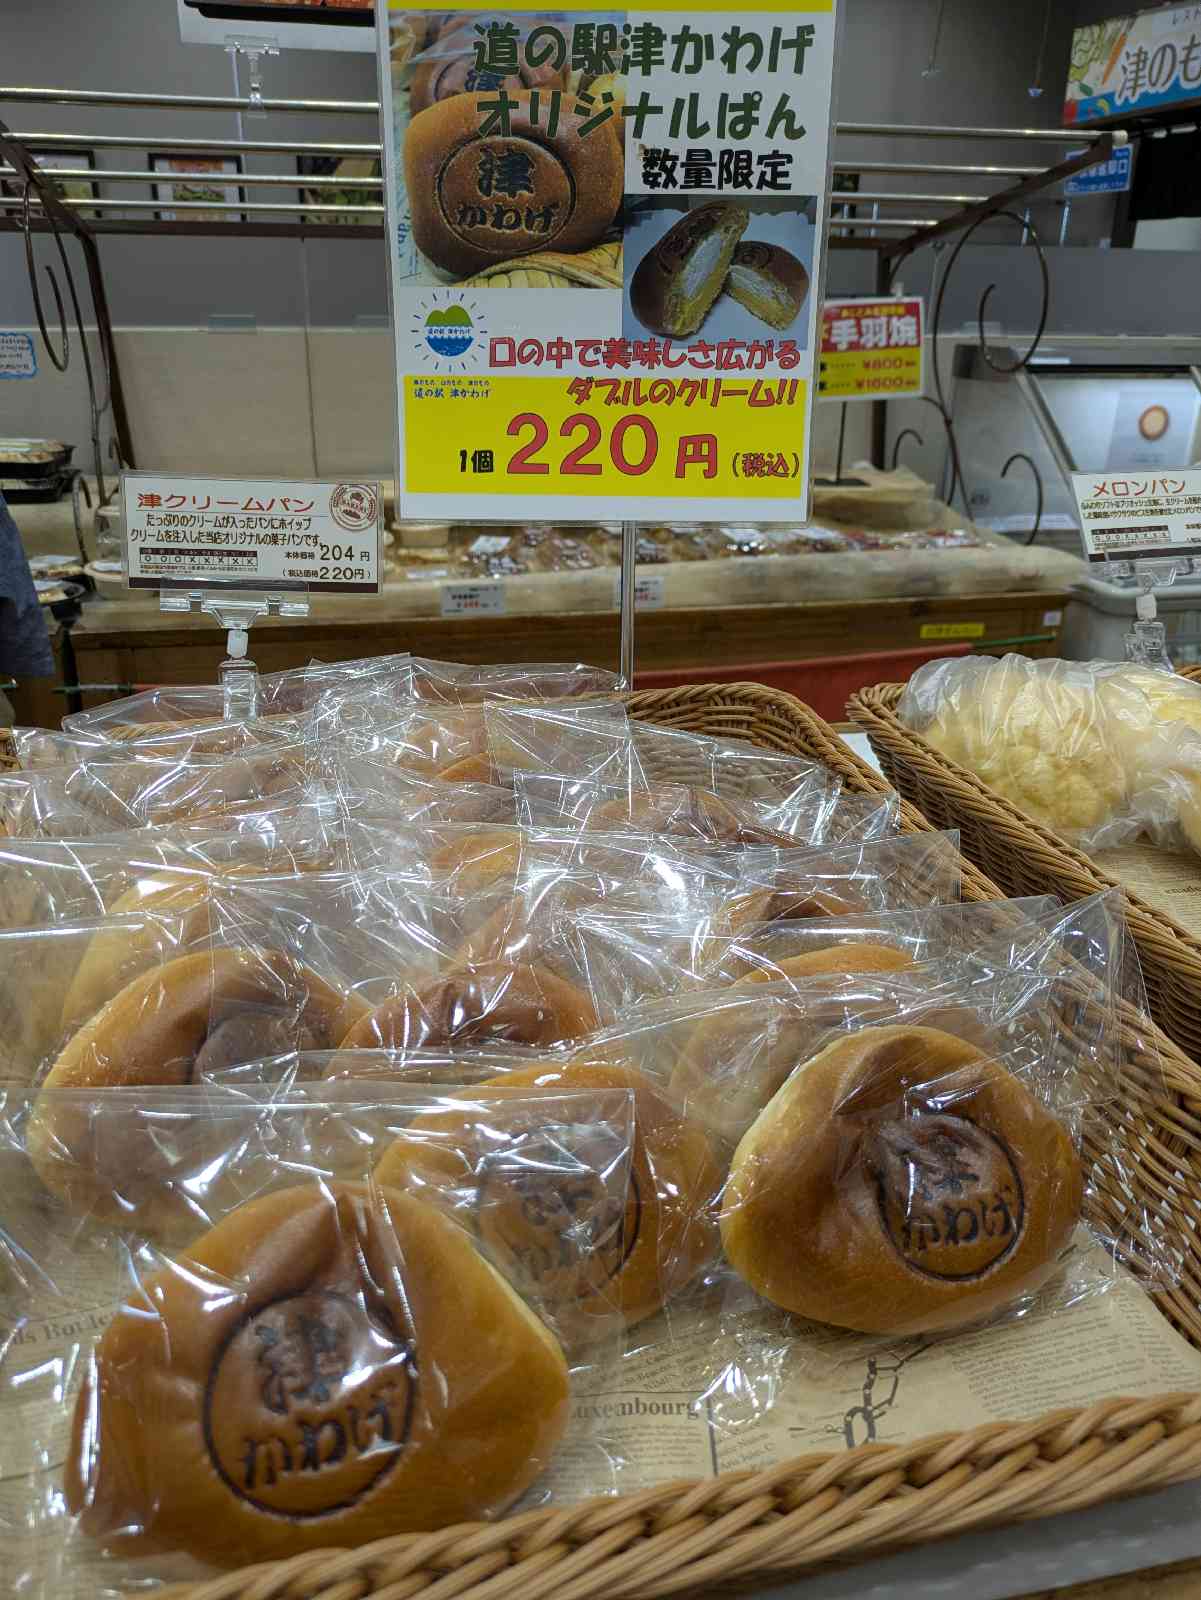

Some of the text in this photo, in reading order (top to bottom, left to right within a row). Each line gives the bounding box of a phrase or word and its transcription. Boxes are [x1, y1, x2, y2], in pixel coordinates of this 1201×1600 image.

[473, 21, 816, 78] 道の駅津かわげ
[476, 89, 807, 141] オリジナルぱん
[641, 149, 793, 191] 数量限定
[456, 203, 557, 235] かわげ
[488, 337, 802, 371] 口の中で美味しさ広がる
[459, 448, 495, 474] 1個
[137, 492, 315, 513] 津クリームパン
[1093, 478, 1186, 498] メロンパン
[145, 513, 313, 531] たっぷりのクリームが入ったパンにホイップ
[570, 1397, 700, 1419] uxembourg
